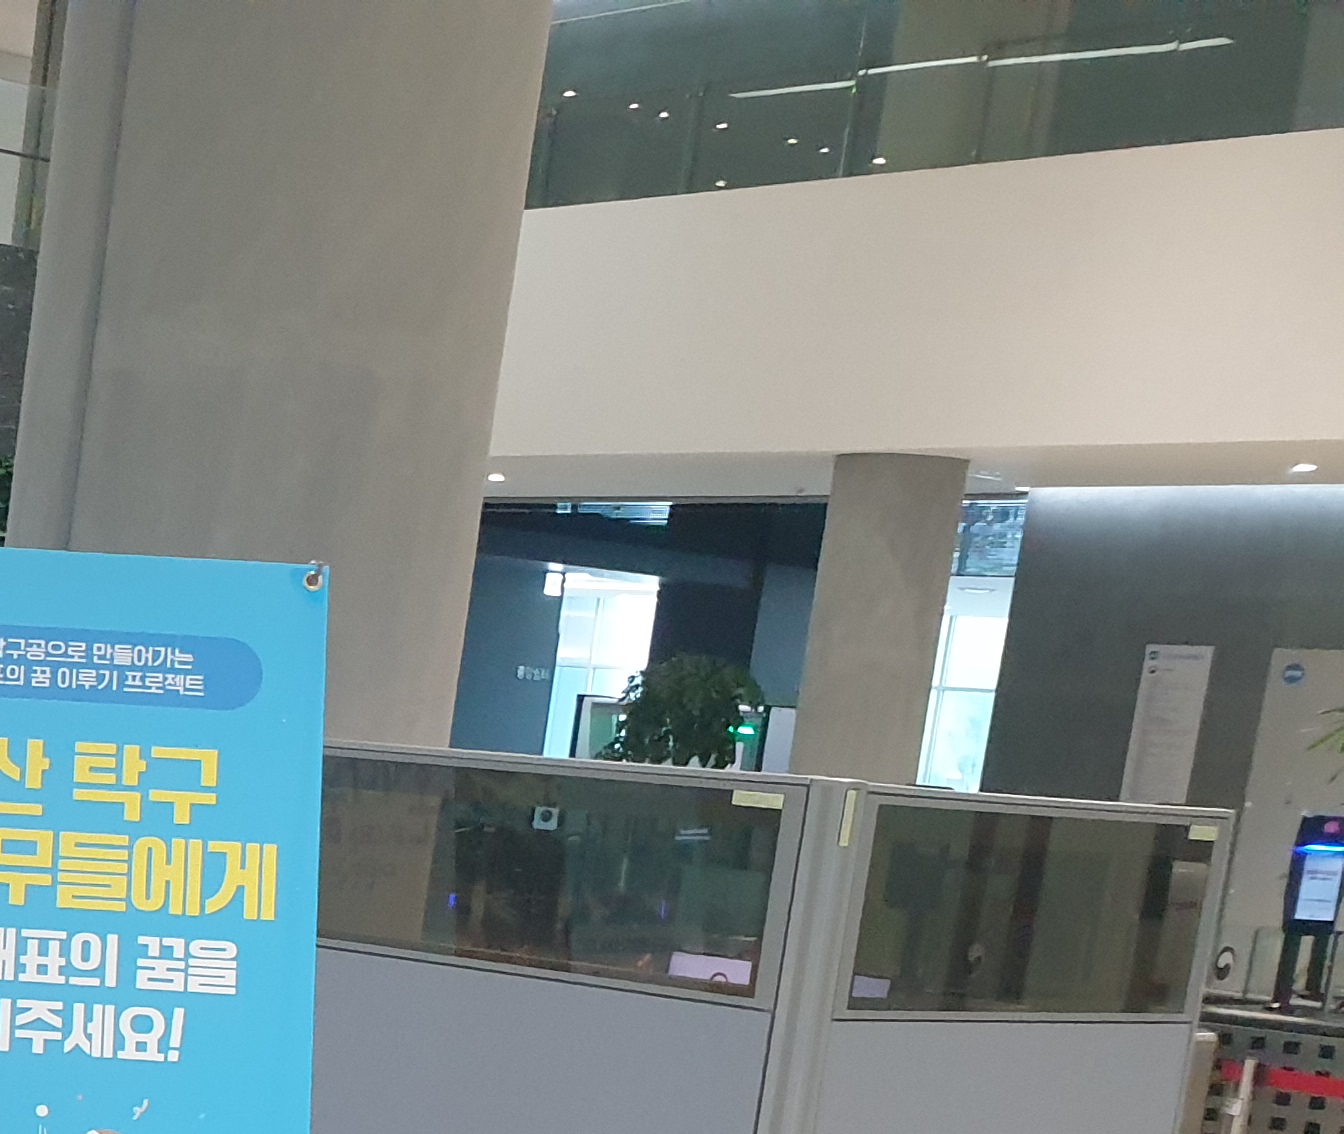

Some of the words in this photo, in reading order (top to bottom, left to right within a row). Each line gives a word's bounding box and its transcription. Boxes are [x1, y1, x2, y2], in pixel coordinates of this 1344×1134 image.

[93, 643, 194, 669] 만들어가는
[31, 666, 51, 687] 꿈
[57, 667, 118, 690] 이루기
[123, 671, 204, 696] 프로젝트
[72, 742, 218, 824] 탁구
[136, 936, 237, 994] 꿈을
